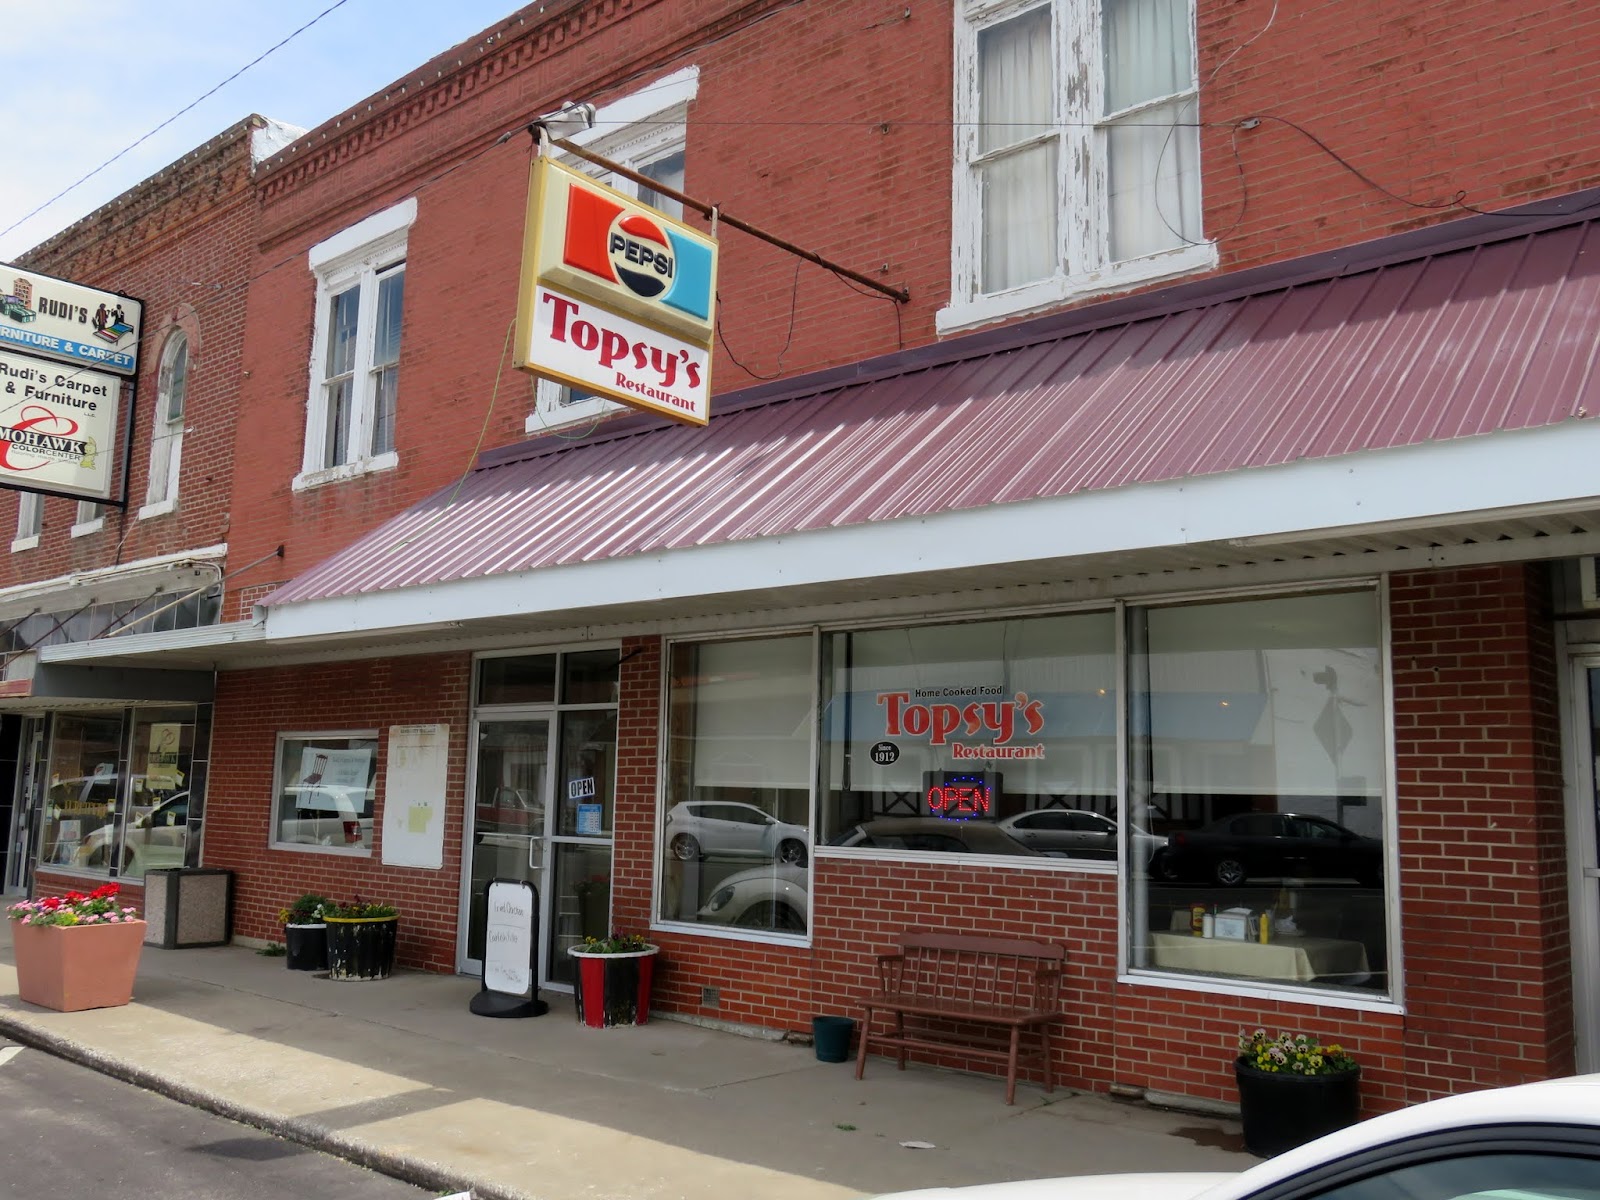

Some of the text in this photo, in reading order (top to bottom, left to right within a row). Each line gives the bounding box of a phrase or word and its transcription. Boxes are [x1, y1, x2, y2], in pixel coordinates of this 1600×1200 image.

[609, 231, 674, 279] PEPSI
[38, 296, 88, 325] RUDI'S
[64, 342, 74, 353] &
[79, 345, 131, 365] CARPET
[542, 291, 701, 389] Topsy's
[0, 362, 107, 397] Rudi's Carpet
[615, 371, 697, 413] Restaurant
[5, 381, 97, 411] & Furniture
[915, 686, 1002, 698] Home Cooked Food
[876, 691, 1045, 745] Topsy's
[874, 751, 895, 763] 1912
[878, 743, 892, 751] Since
[952, 742, 1045, 760] Restaurant
[571, 778, 593, 798] OPEN
[927, 786, 991, 813] OPEN
